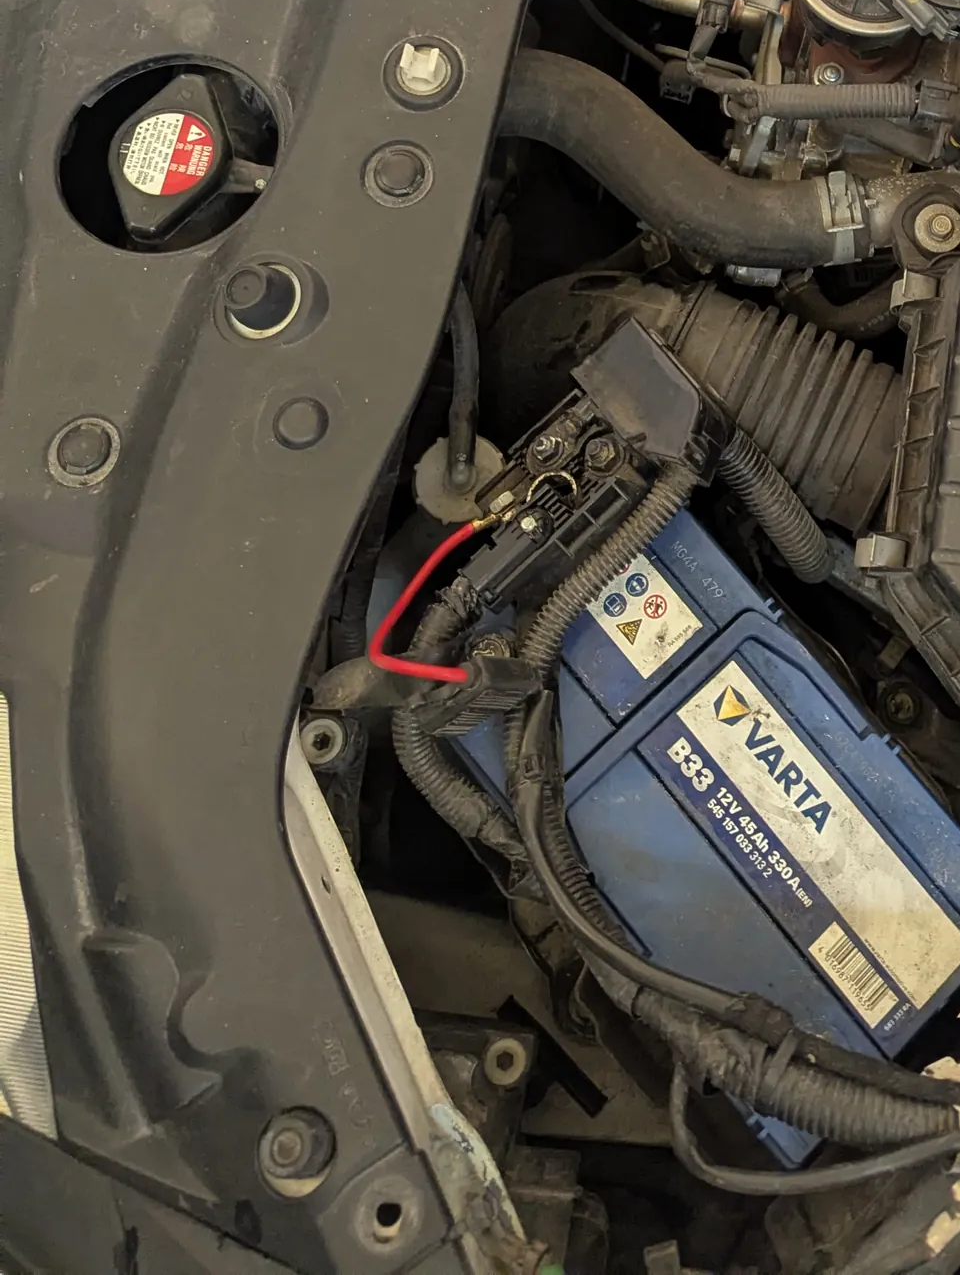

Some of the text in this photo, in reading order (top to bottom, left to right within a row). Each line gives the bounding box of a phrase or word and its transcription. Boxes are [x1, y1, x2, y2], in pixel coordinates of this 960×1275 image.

[195, 146, 212, 177] DANGER
[700, 574, 725, 600] 479
[666, 736, 715, 793] B33
[744, 718, 833, 835] VARTA
[705, 799, 774, 879] 545 157 033 313 2
[715, 786, 740, 815] 12V
[738, 815, 770, 852] 45Ah
